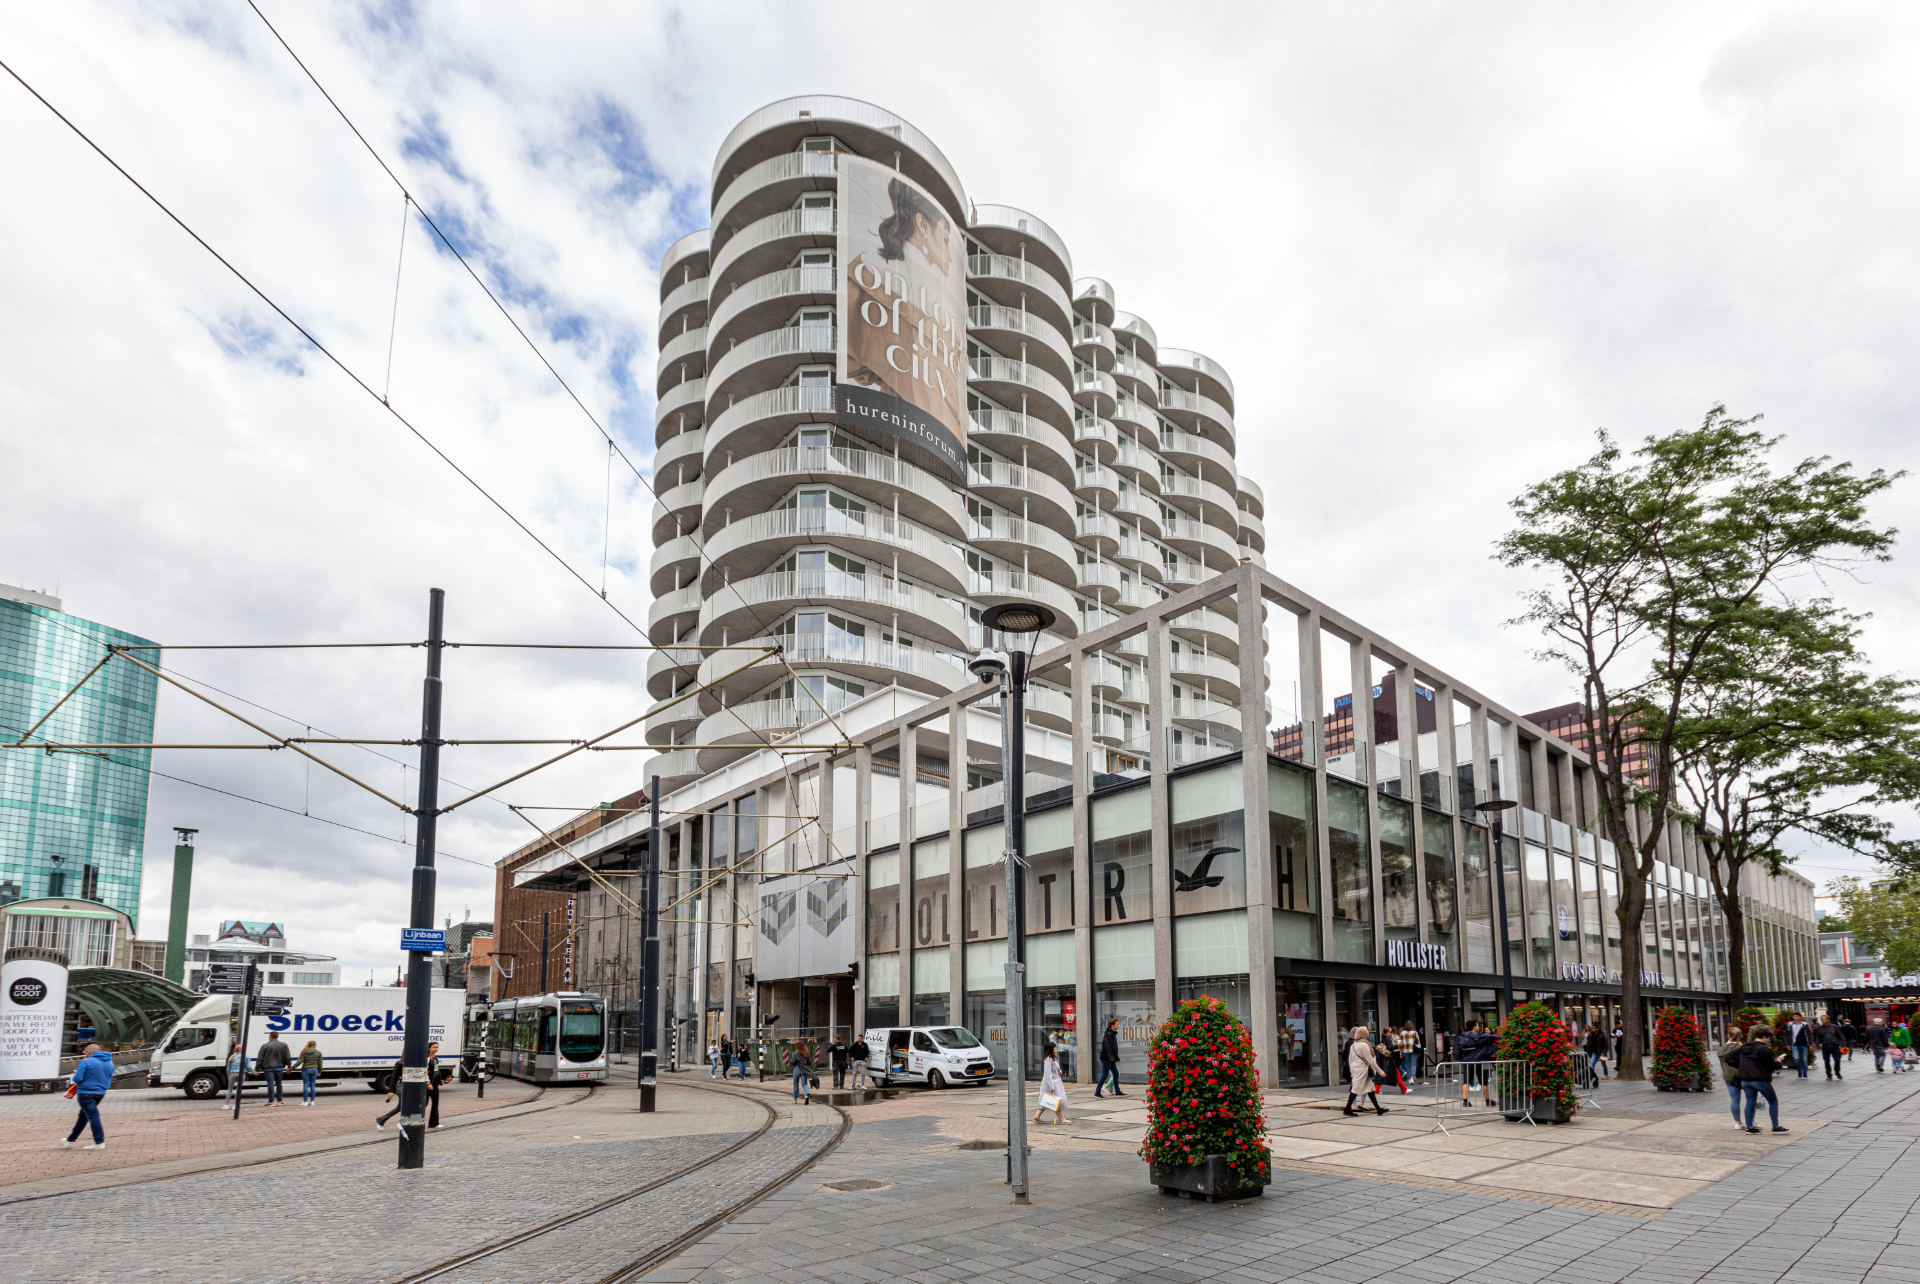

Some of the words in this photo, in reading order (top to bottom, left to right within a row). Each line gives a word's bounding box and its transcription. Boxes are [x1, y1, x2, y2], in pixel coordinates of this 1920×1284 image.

[854, 262, 908, 304] on
[919, 285, 963, 352] top
[861, 298, 911, 335] of
[914, 319, 961, 380] the
[886, 344, 951, 403] city
[1335, 696, 1352, 708] Alli
[405, 930, 442, 940] Lijnbaan
[564, 899, 574, 984] ROTTERDAM
[1388, 939, 1447, 970] HOLLISTER
[1562, 961, 1607, 982] COSTES
[265, 1009, 405, 1032] Snoeck
[35, 1049, 53, 1057] MEE
